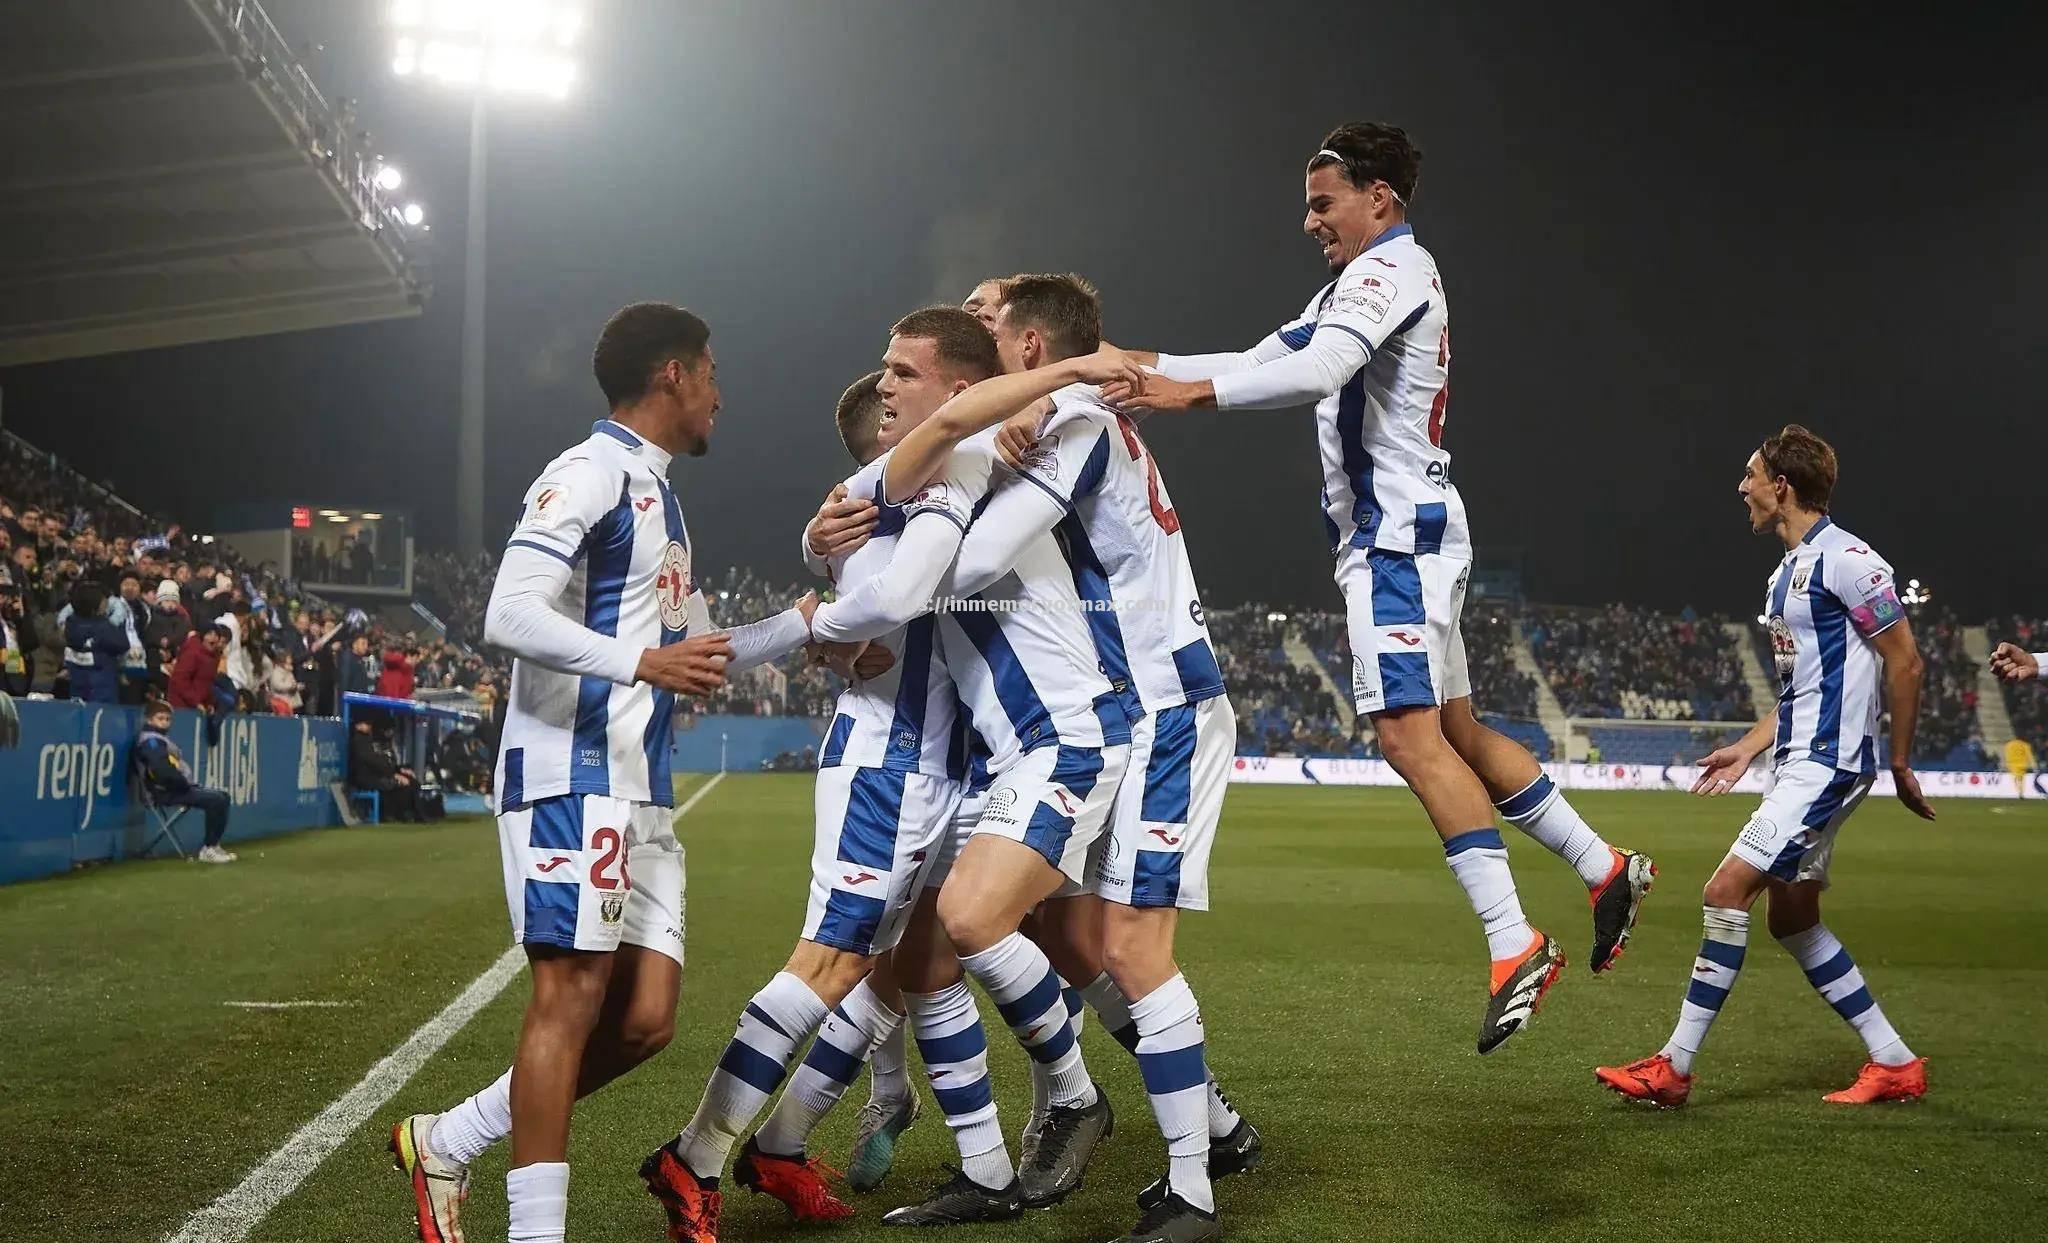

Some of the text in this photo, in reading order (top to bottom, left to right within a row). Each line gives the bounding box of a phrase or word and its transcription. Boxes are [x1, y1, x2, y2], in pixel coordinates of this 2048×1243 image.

[898, 738, 915, 749] 2023
[581, 749, 600, 758] 1993
[581, 757, 600, 767] 2023
[37, 707, 115, 830] renfe
